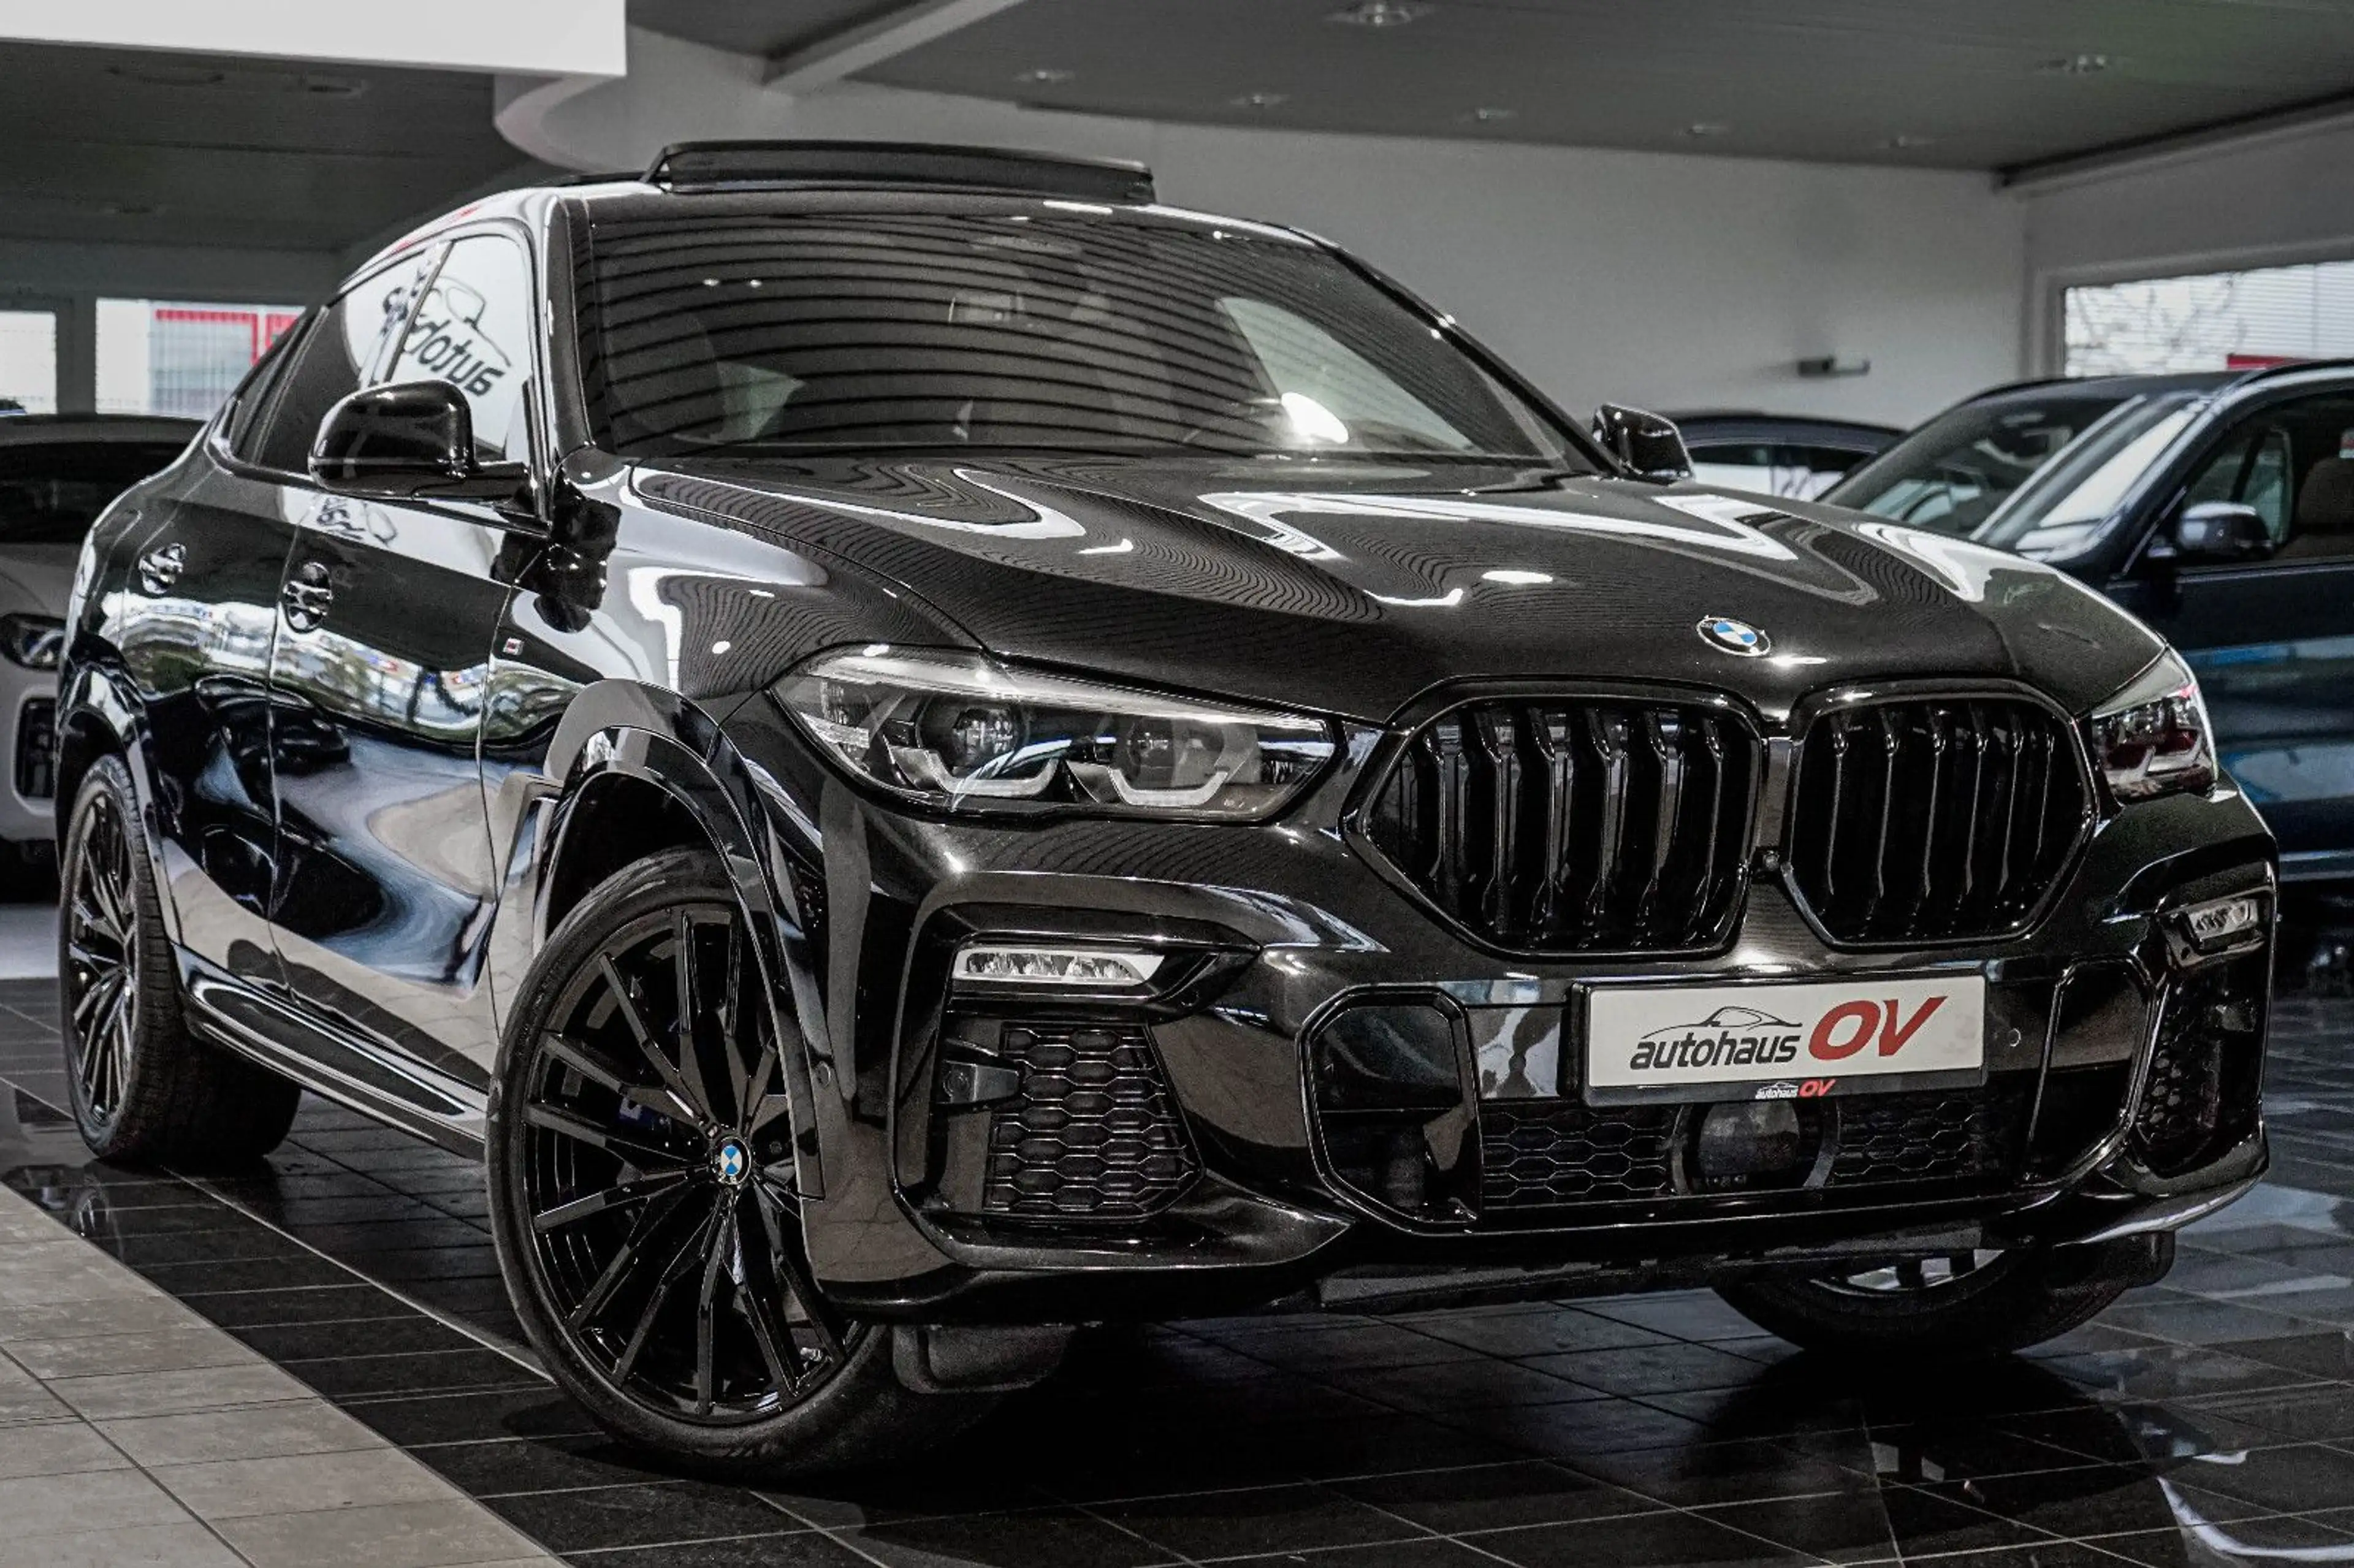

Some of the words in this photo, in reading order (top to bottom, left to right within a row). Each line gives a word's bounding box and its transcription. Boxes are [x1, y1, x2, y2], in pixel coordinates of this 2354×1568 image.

[1630, 1031, 1802, 1069] autohaus
[1808, 995, 1948, 1060] OV
[1755, 1087, 1799, 1099] autohaus
[1799, 1079, 1836, 1097] OV
